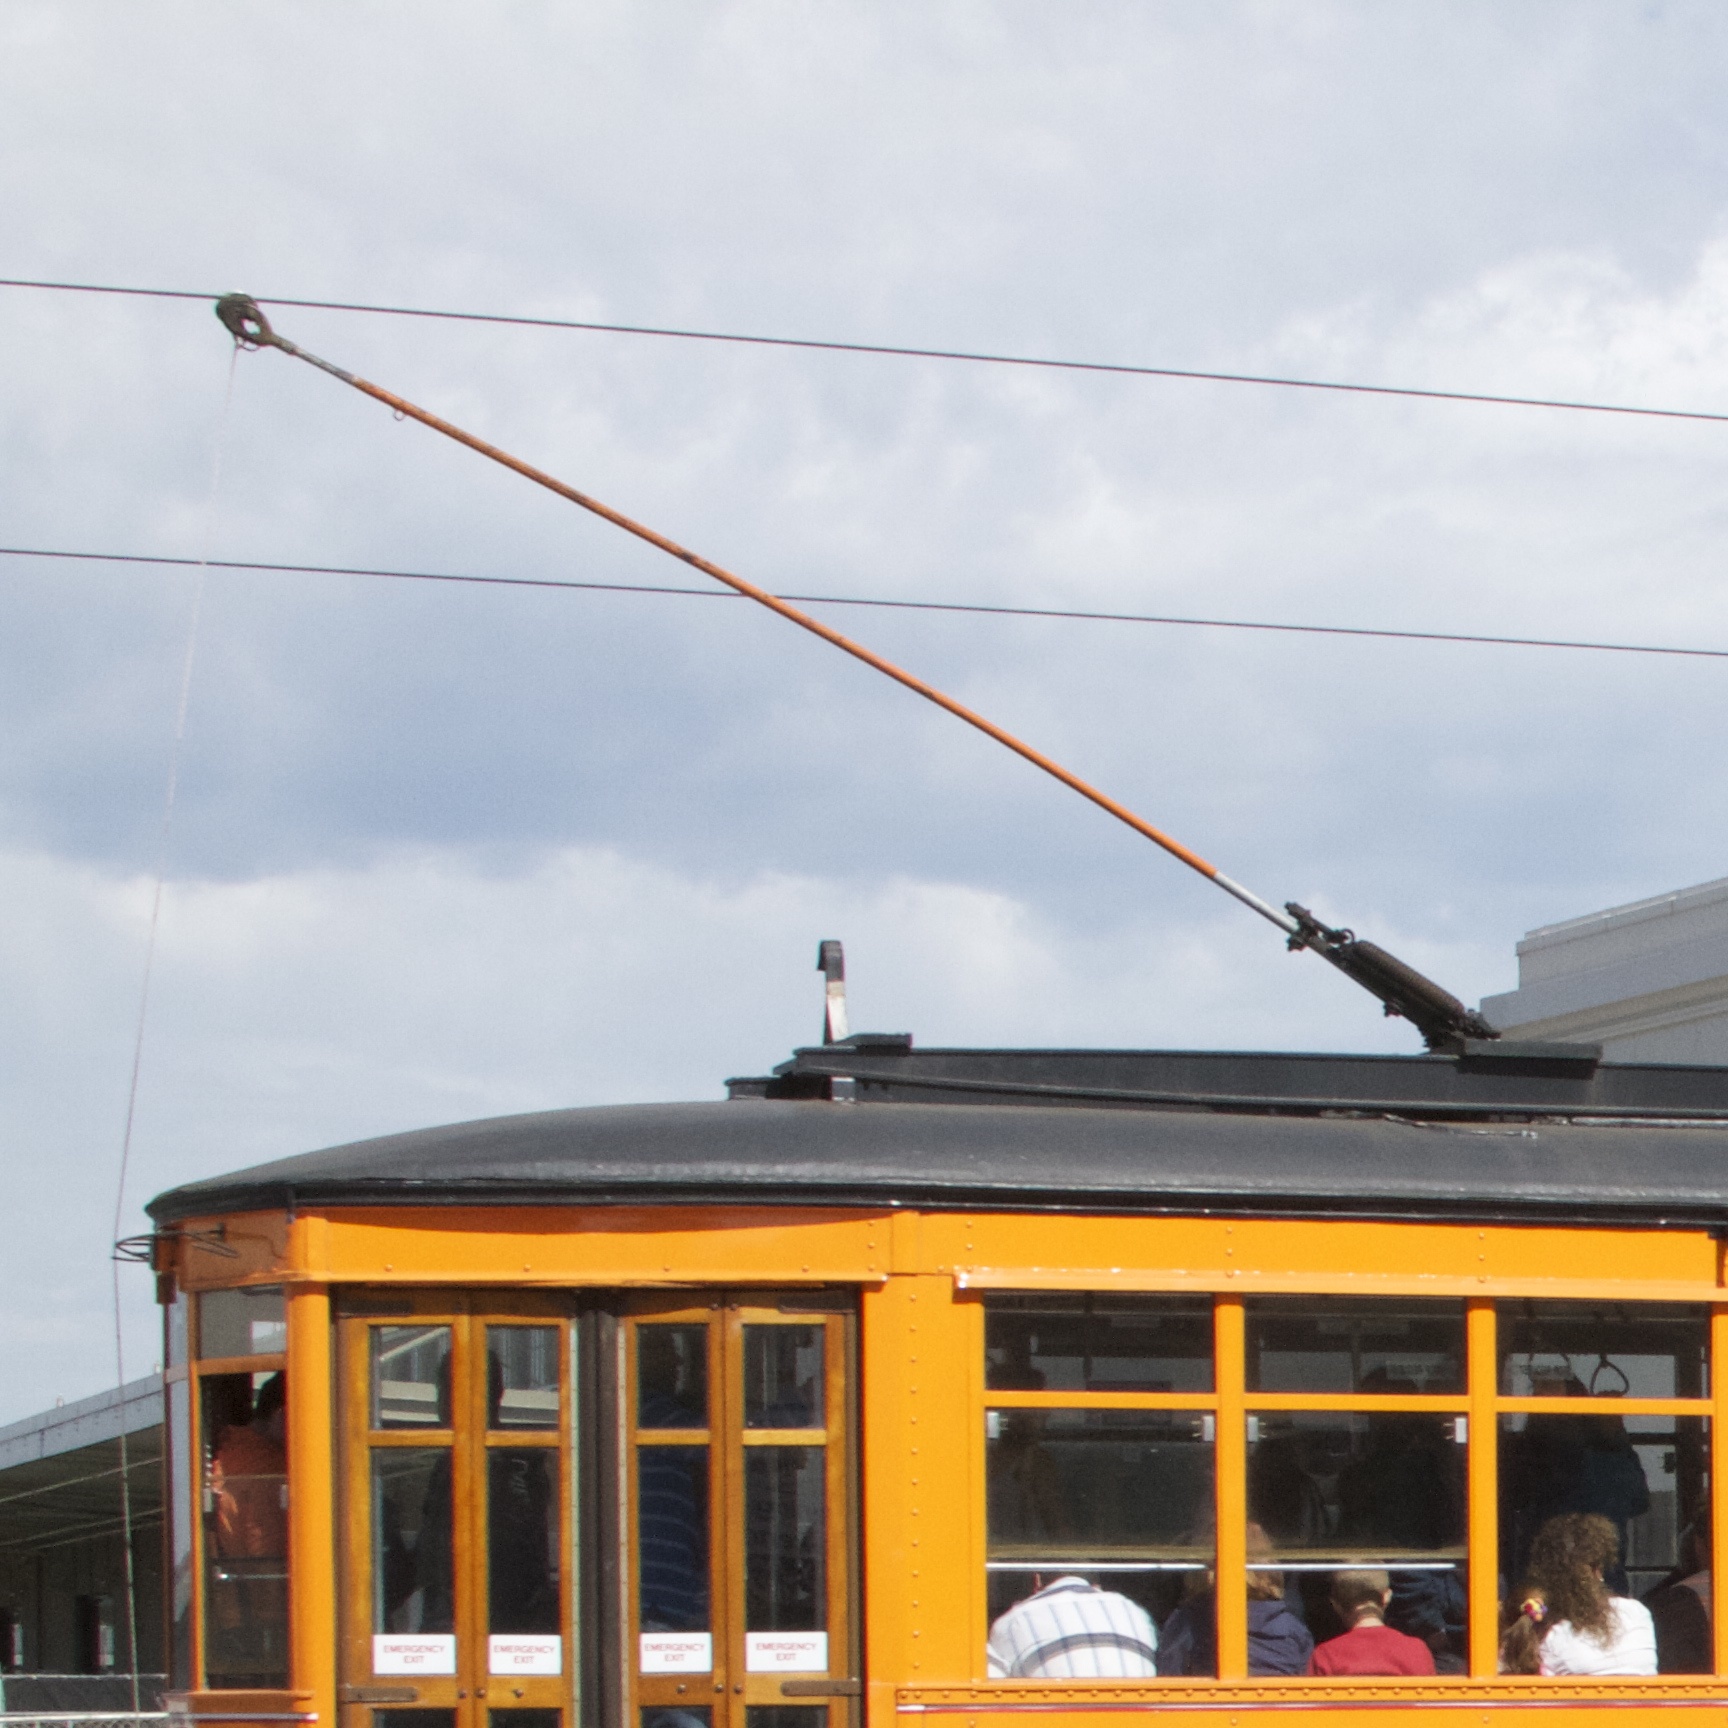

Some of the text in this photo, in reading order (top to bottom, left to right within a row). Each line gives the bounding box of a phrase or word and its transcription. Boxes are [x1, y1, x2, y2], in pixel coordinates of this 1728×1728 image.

[383, 1645, 445, 1654] EMERGENCY
[493, 1645, 555, 1654] EMERGENCY
[644, 1643, 705, 1652] EMERGENCY
[755, 1642, 817, 1651] EMERGENCY
[403, 1655, 425, 1664] EXIT
[513, 1655, 535, 1664] EXIT
[664, 1653, 685, 1662] EXIT
[776, 1652, 796, 1661] EXIT
